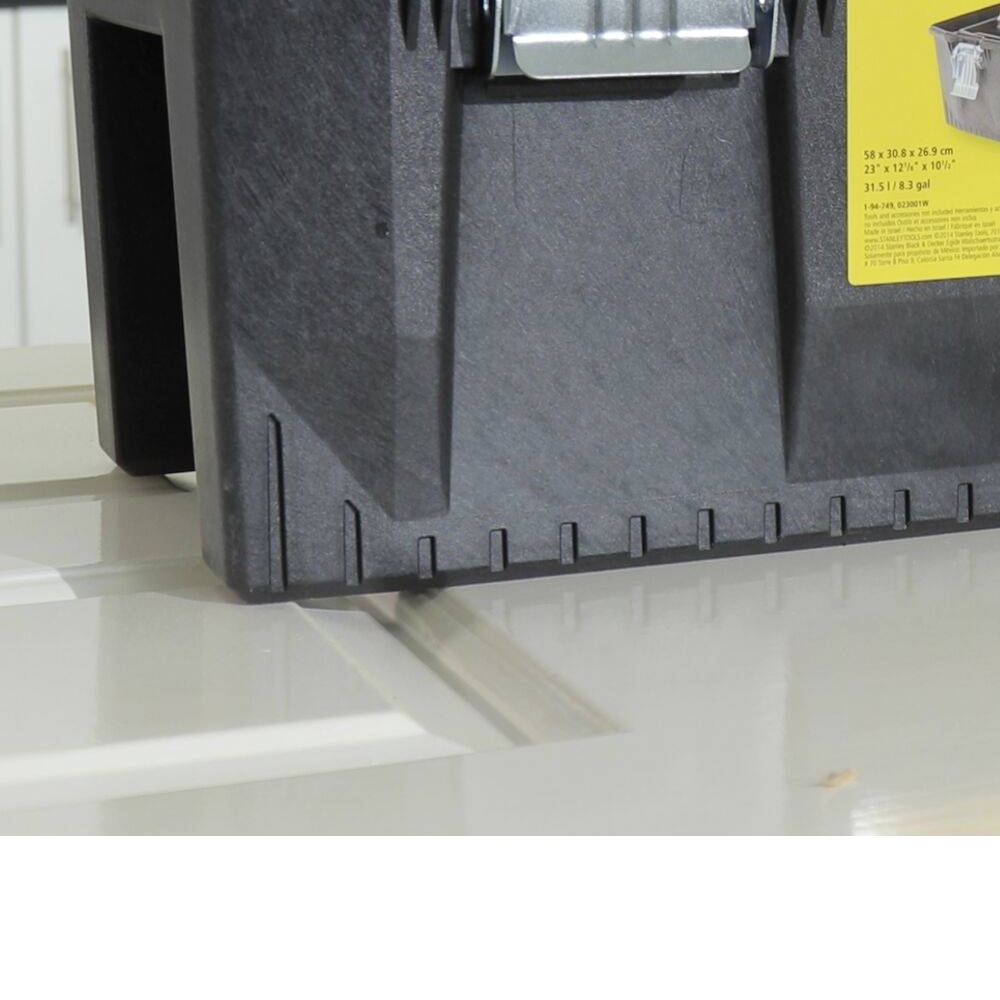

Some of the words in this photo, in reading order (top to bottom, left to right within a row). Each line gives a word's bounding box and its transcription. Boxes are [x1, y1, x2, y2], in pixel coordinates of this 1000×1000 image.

[864, 150, 876, 160] 58
[879, 151, 884, 159] x
[918, 146, 937, 157] 26.9
[940, 147, 954, 156] cm
[884, 165, 890, 173] x
[922, 163, 927, 171] x
[864, 182, 884, 193] 31.5
[899, 180, 913, 190] 8.3
[916, 179, 930, 192] gal
